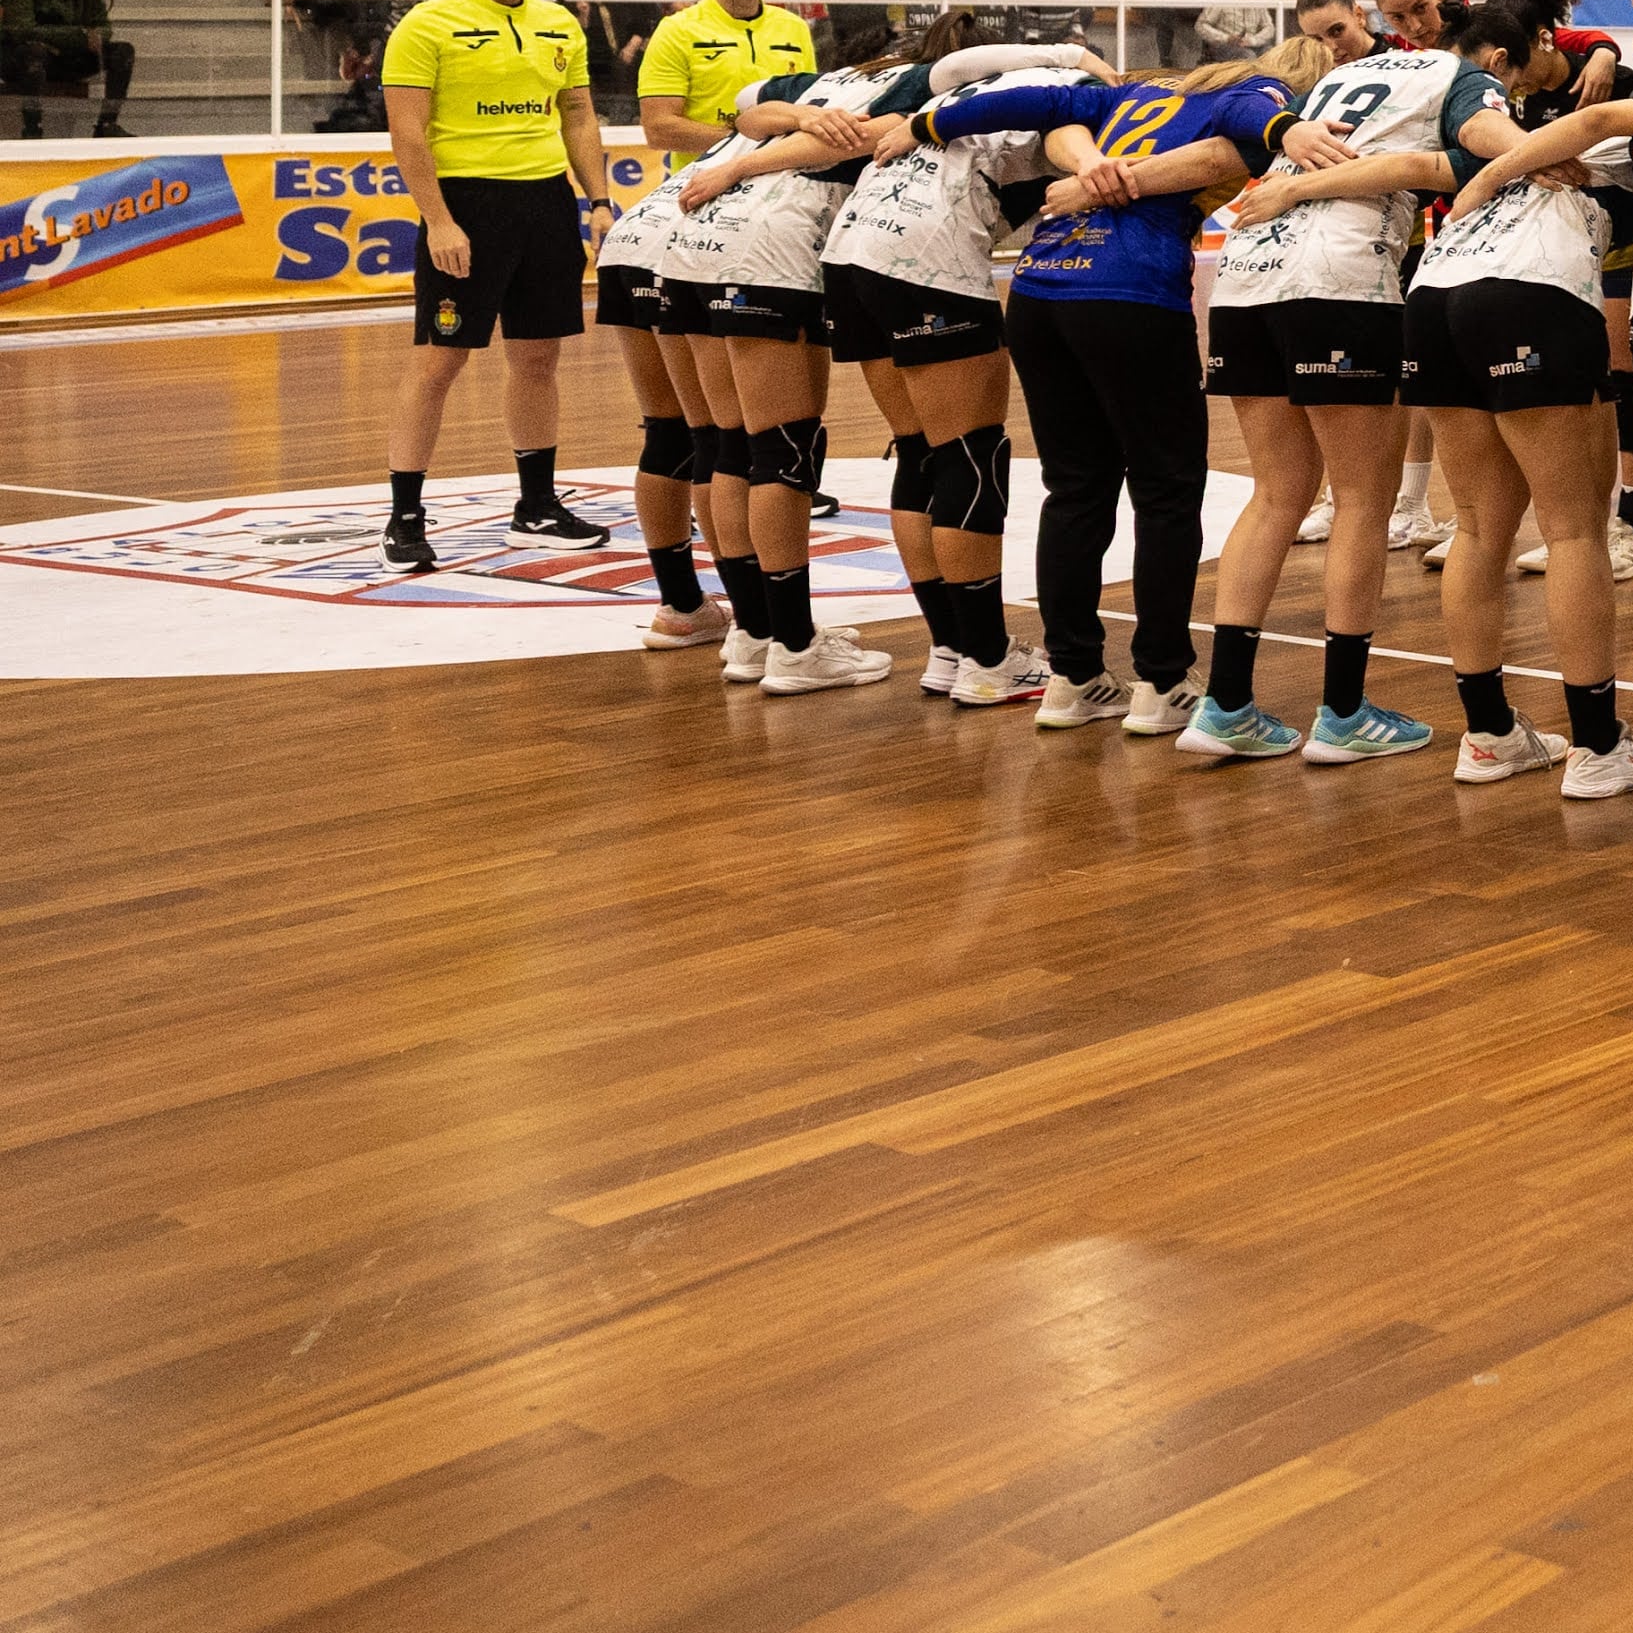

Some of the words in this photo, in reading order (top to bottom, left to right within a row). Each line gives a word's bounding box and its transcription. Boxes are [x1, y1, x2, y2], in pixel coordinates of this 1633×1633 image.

[476, 100, 543, 116] helvetia
[1095, 95, 1186, 158] 12
[273, 159, 412, 200] Esta
[45, 177, 191, 249] Lavado
[1295, 362, 1337, 375] suma
